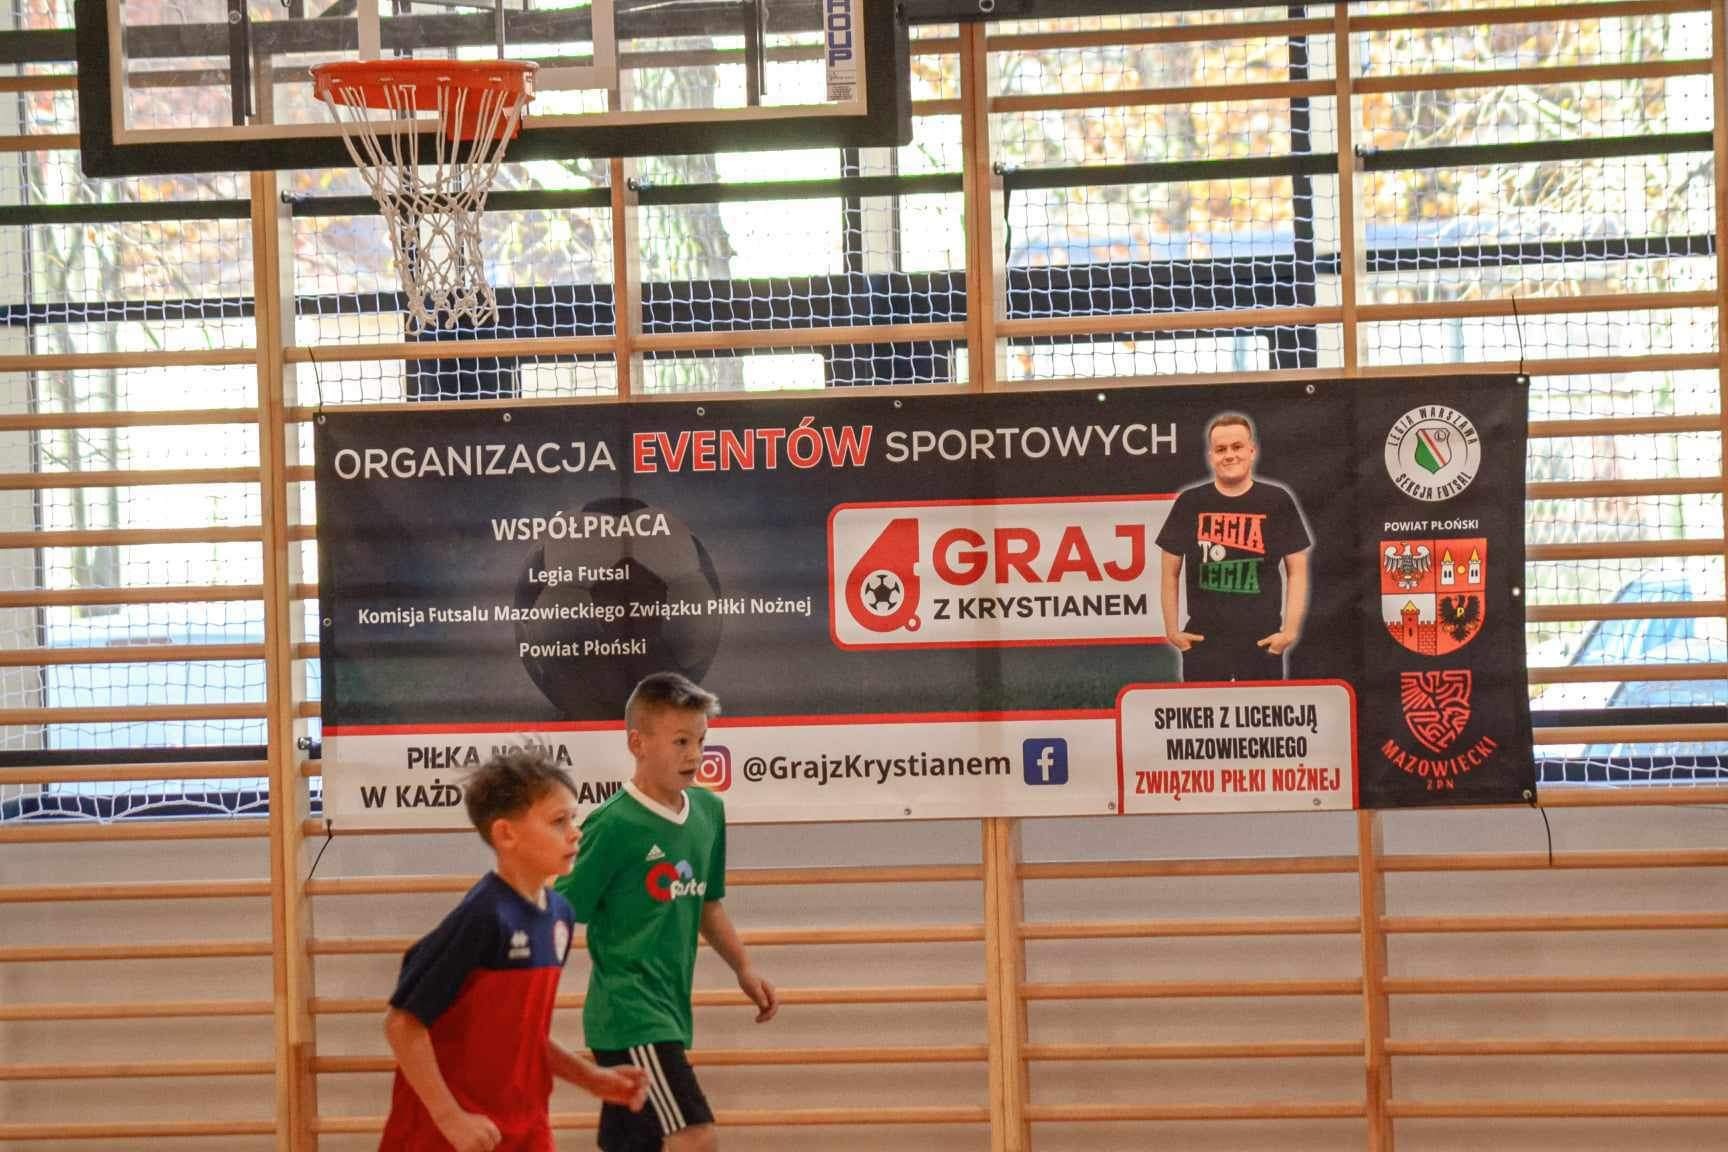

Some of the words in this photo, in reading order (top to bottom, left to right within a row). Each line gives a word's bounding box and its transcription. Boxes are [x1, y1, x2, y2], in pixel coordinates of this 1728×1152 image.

[1388, 415, 1414, 447] LEGIA
[1419, 407, 1478, 446] WARSZAWA
[334, 441, 616, 479] ORGANIZACJA
[633, 416, 873, 473] EVENTÓW
[885, 423, 1177, 462] SPORTOWYCH
[1395, 473, 1433, 500] SEKCJA
[1438, 471, 1472, 499] FUTSAL
[492, 511, 671, 541] WSPÓŁPRACA
[1198, 512, 1266, 555] LEGIA
[1384, 520, 1428, 532] POWIAT
[1431, 517, 1479, 530] PŁOŃSKI
[932, 524, 1146, 586] GRAJ
[528, 566, 573, 586] Legia
[578, 564, 630, 582] Futsal
[1200, 557, 1264, 593] LEGIA
[358, 607, 425, 627] Komisja
[428, 604, 488, 622] Futsalu
[494, 602, 625, 622] Mazowieckiego
[629, 599, 701, 620] Związku
[707, 597, 745, 615] Piłki
[751, 596, 812, 617] Nożnej
[933, 598, 950, 620] Z
[959, 594, 1147, 619] KRYSTIANEM
[519, 640, 579, 658] Powiat
[584, 638, 647, 656] Płoński
[1154, 706, 1214, 730] SPIKER
[1219, 706, 1230, 728] Z
[1235, 704, 1318, 733] LICENCJĄ
[407, 746, 480, 770] PIŁKA
[1166, 736, 1308, 761] MAZOWIECKIEGO
[1381, 735, 1499, 778] MAZOWIECKI
[743, 752, 1011, 785] @GrajzKrystianem
[1136, 770, 1215, 801] ZWIĄZKU
[1221, 768, 1266, 793] PIŁKI
[1272, 763, 1340, 792] NOŻNEJ
[360, 785, 387, 808] W
